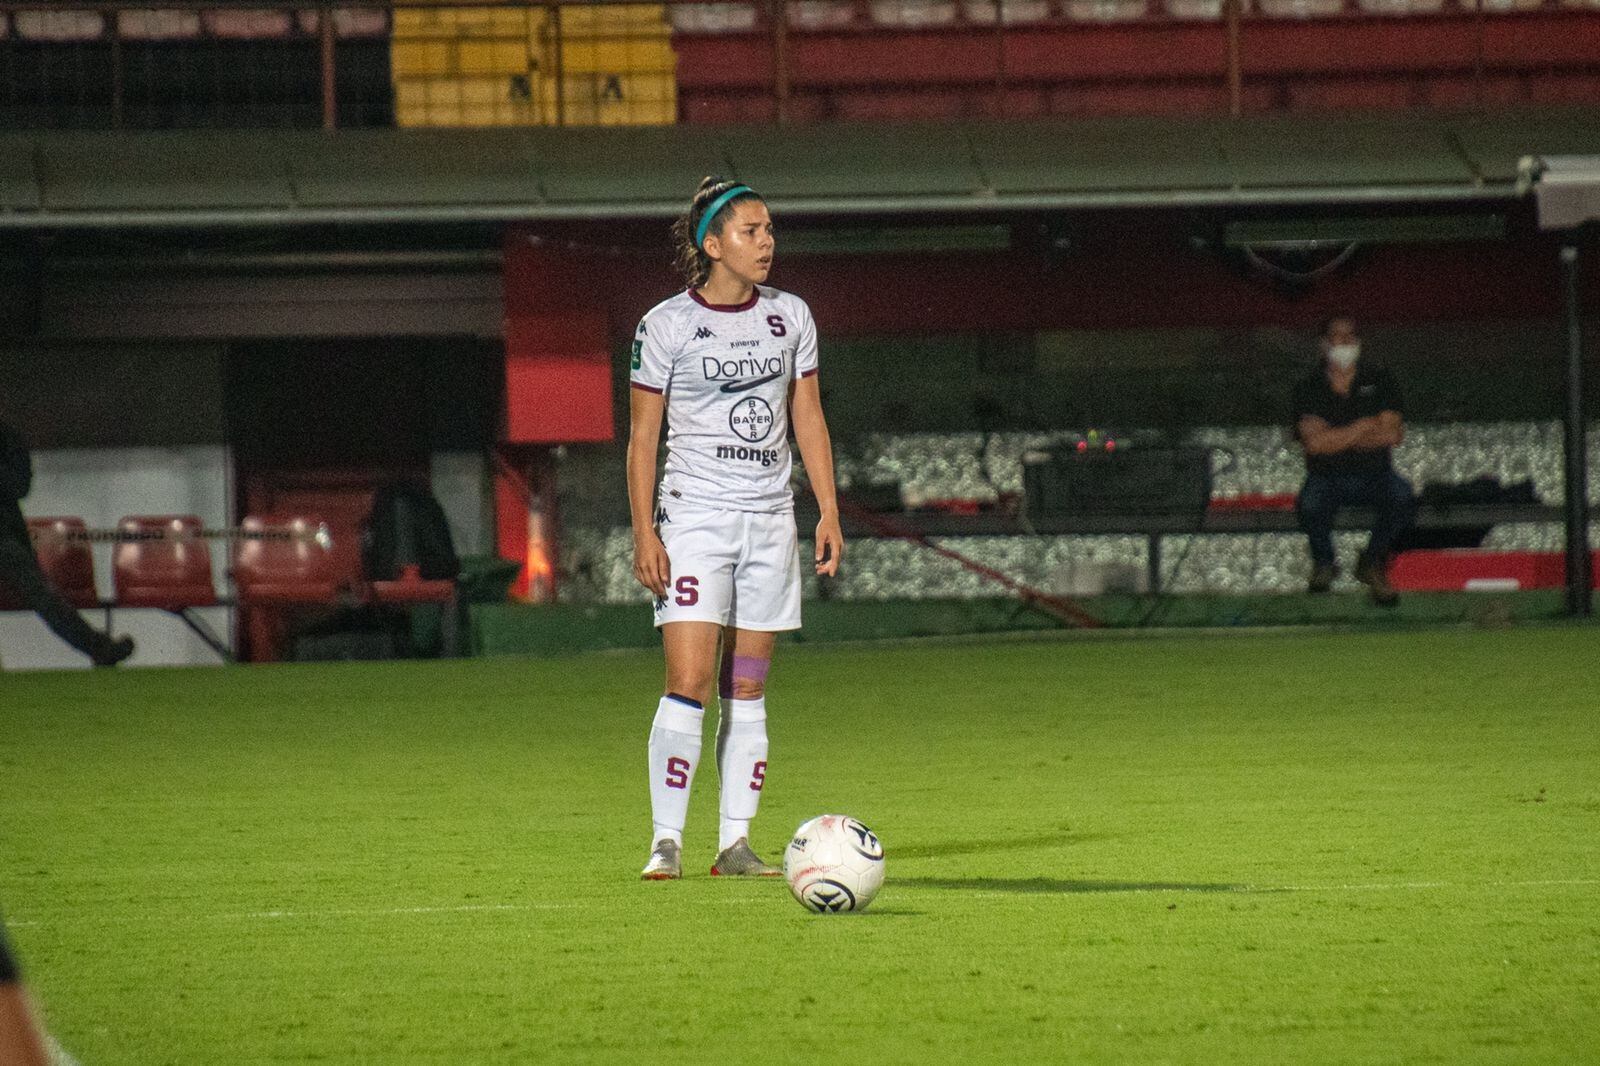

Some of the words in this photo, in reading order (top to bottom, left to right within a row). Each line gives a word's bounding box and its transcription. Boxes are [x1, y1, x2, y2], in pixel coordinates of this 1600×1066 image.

[767, 315, 786, 337] S
[702, 349, 785, 380] Dorival
[733, 416, 772, 424] BAYER
[748, 400, 758, 439] BAYER
[716, 446, 778, 466] monge
[675, 575, 699, 606] S
[665, 757, 690, 789] S
[749, 761, 767, 790] S
